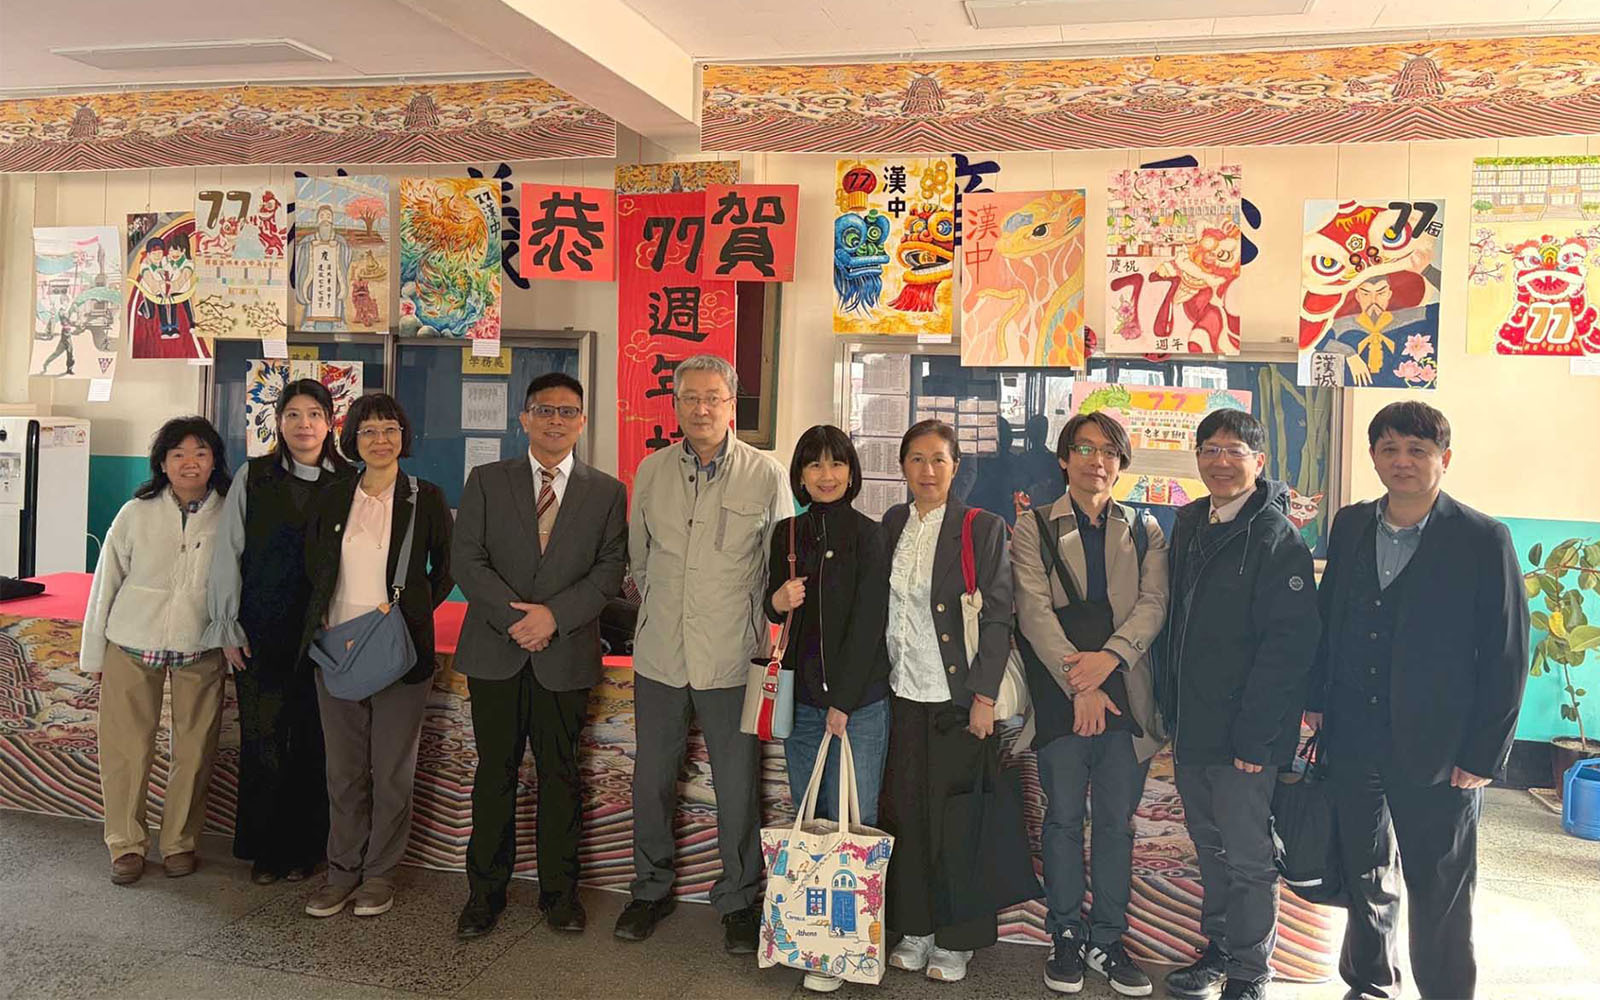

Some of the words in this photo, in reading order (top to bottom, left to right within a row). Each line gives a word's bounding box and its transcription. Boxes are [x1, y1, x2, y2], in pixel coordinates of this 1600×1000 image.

[849, 172, 869, 191] 77
[882, 165, 907, 218] 漢中
[198, 190, 251, 230] 77
[528, 191, 604, 272] 恭
[711, 191, 786, 277] 賀
[965, 203, 999, 285] 漢中
[1109, 259, 1139, 273] 慶祝
[1110, 273, 1181, 338] 77
[1528, 304, 1574, 342] 77
[1156, 338, 1184, 350] 週年
[1314, 354, 1337, 388] 漢城
[1148, 392, 1187, 411] 77
